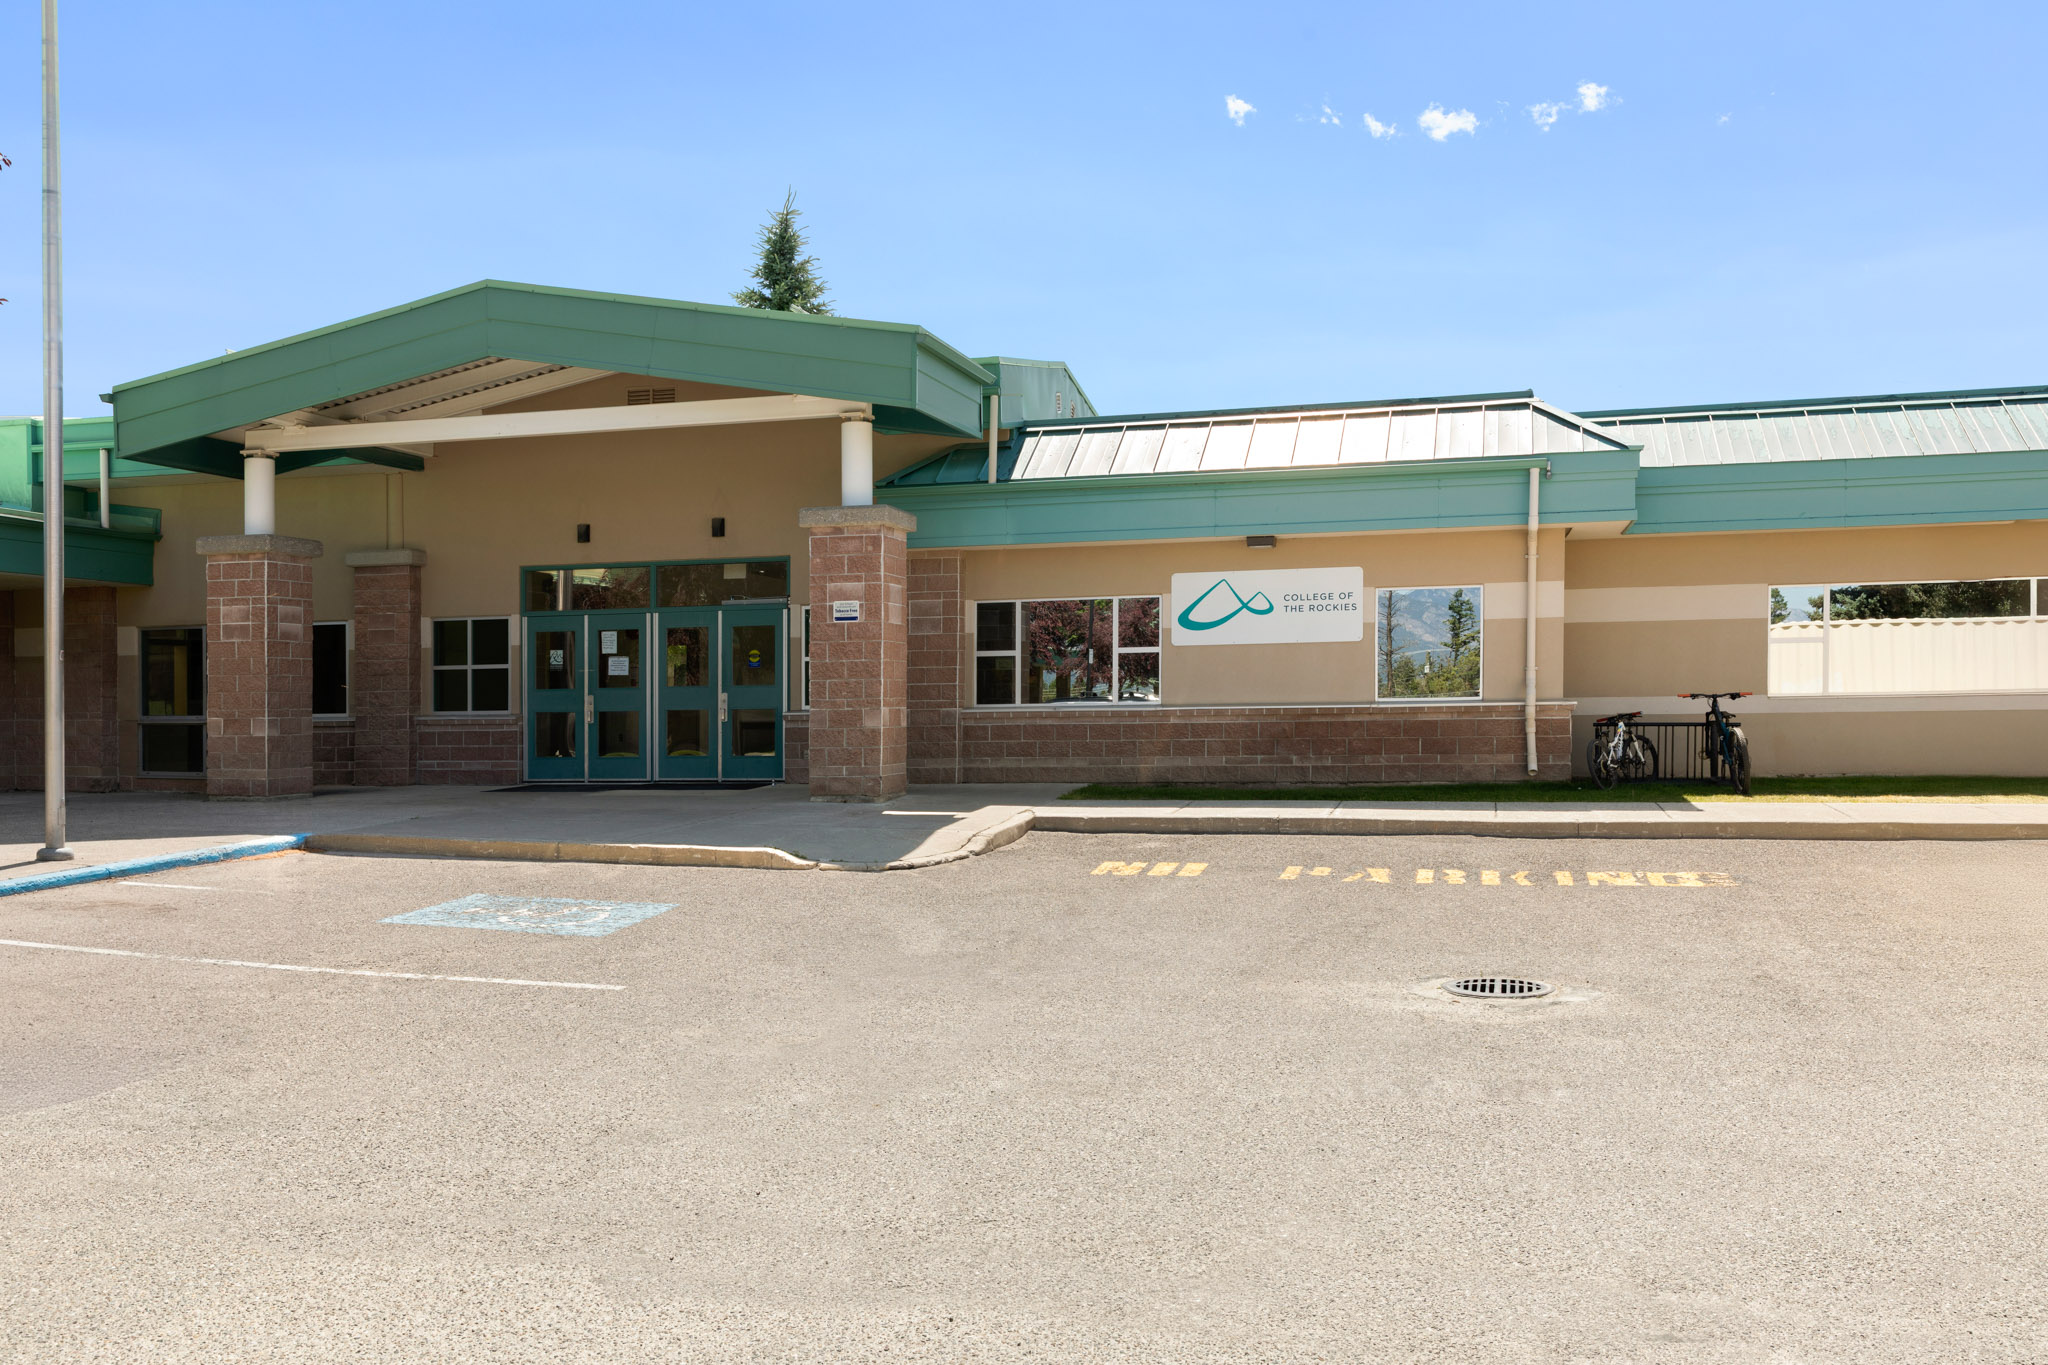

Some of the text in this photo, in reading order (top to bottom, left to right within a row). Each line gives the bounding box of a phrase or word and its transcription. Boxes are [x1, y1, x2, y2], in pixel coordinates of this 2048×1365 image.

[1283, 592, 1353, 601] COLLEGE OF
[1309, 603, 1357, 612] ROCKIES
